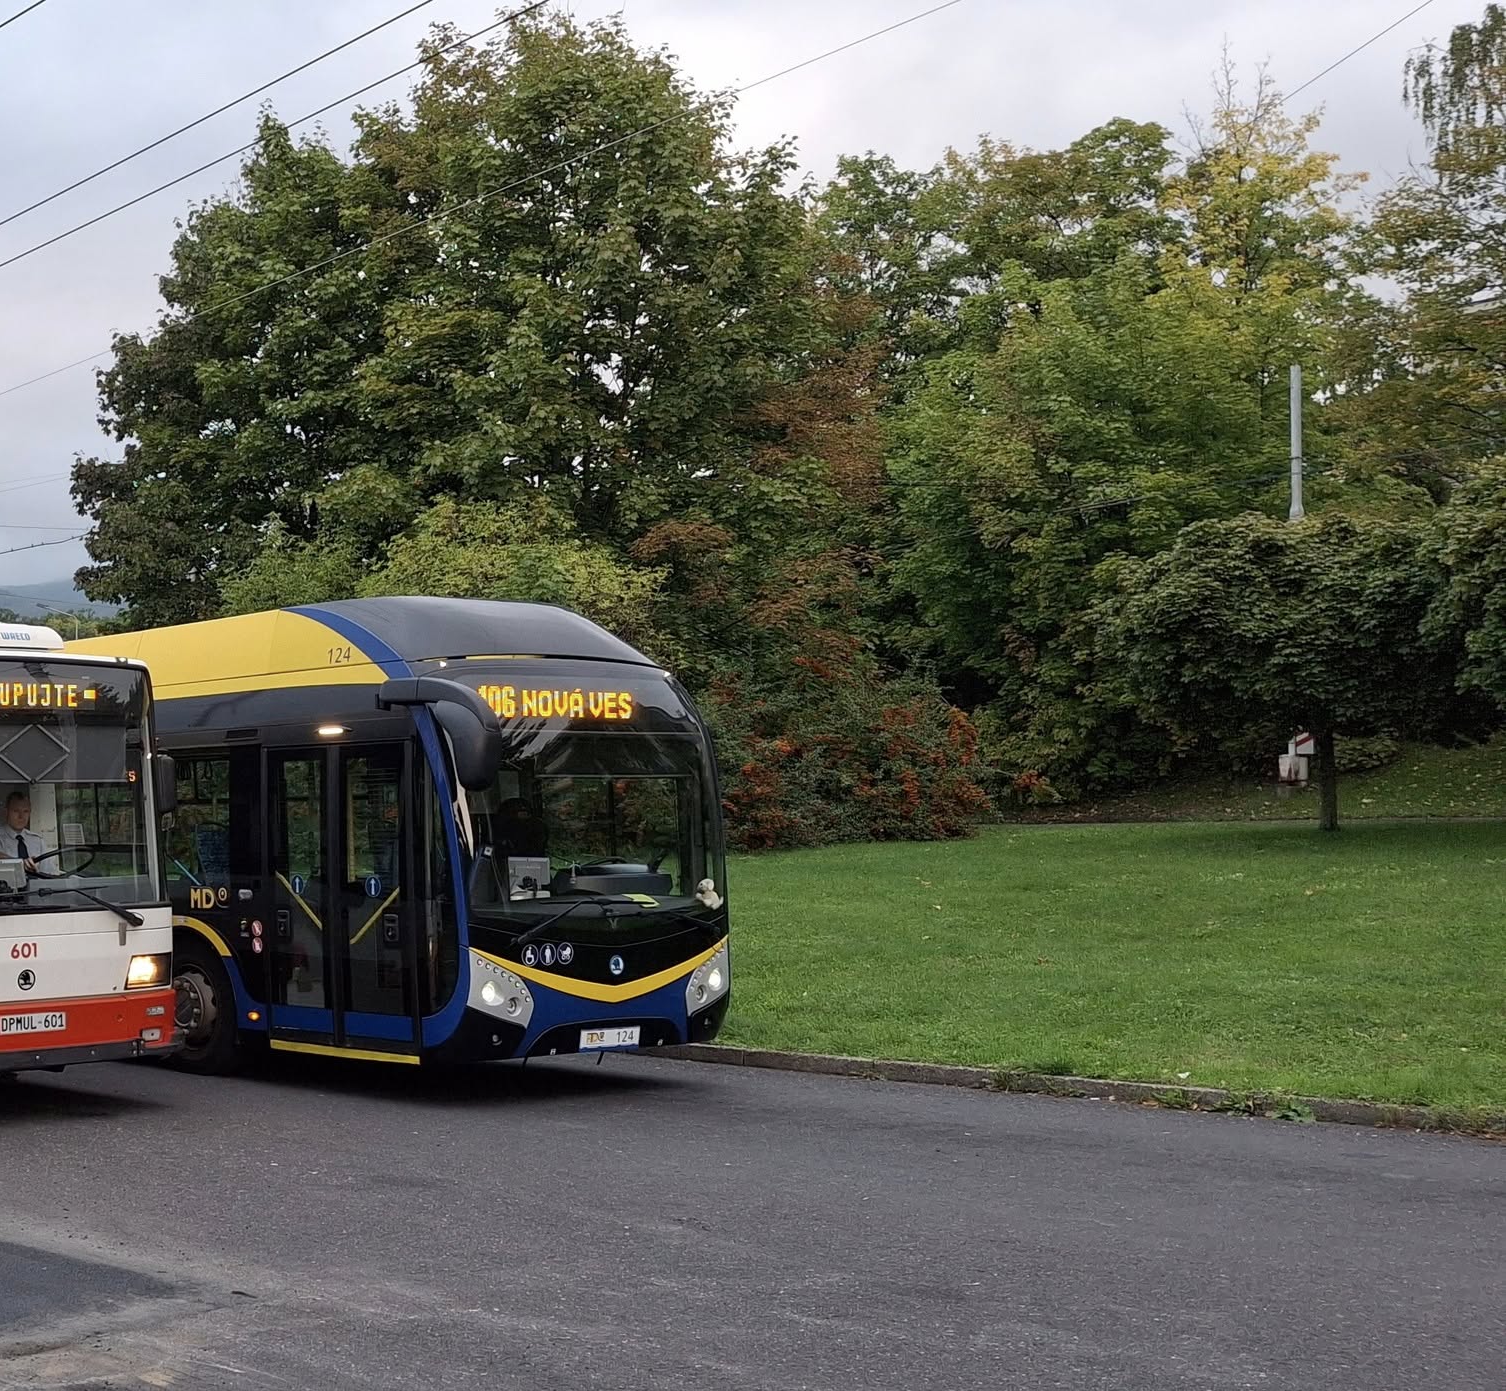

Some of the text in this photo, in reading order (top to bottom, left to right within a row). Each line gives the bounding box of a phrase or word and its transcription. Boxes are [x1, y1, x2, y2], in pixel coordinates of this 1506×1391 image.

[327, 646, 351, 664] 124
[522, 688, 585, 718] NOVÁ
[589, 691, 633, 719] VES
[10, 942, 38, 959] 601
[1, 1013, 65, 1032] DPMUL-601
[616, 1030, 634, 1043] 124
